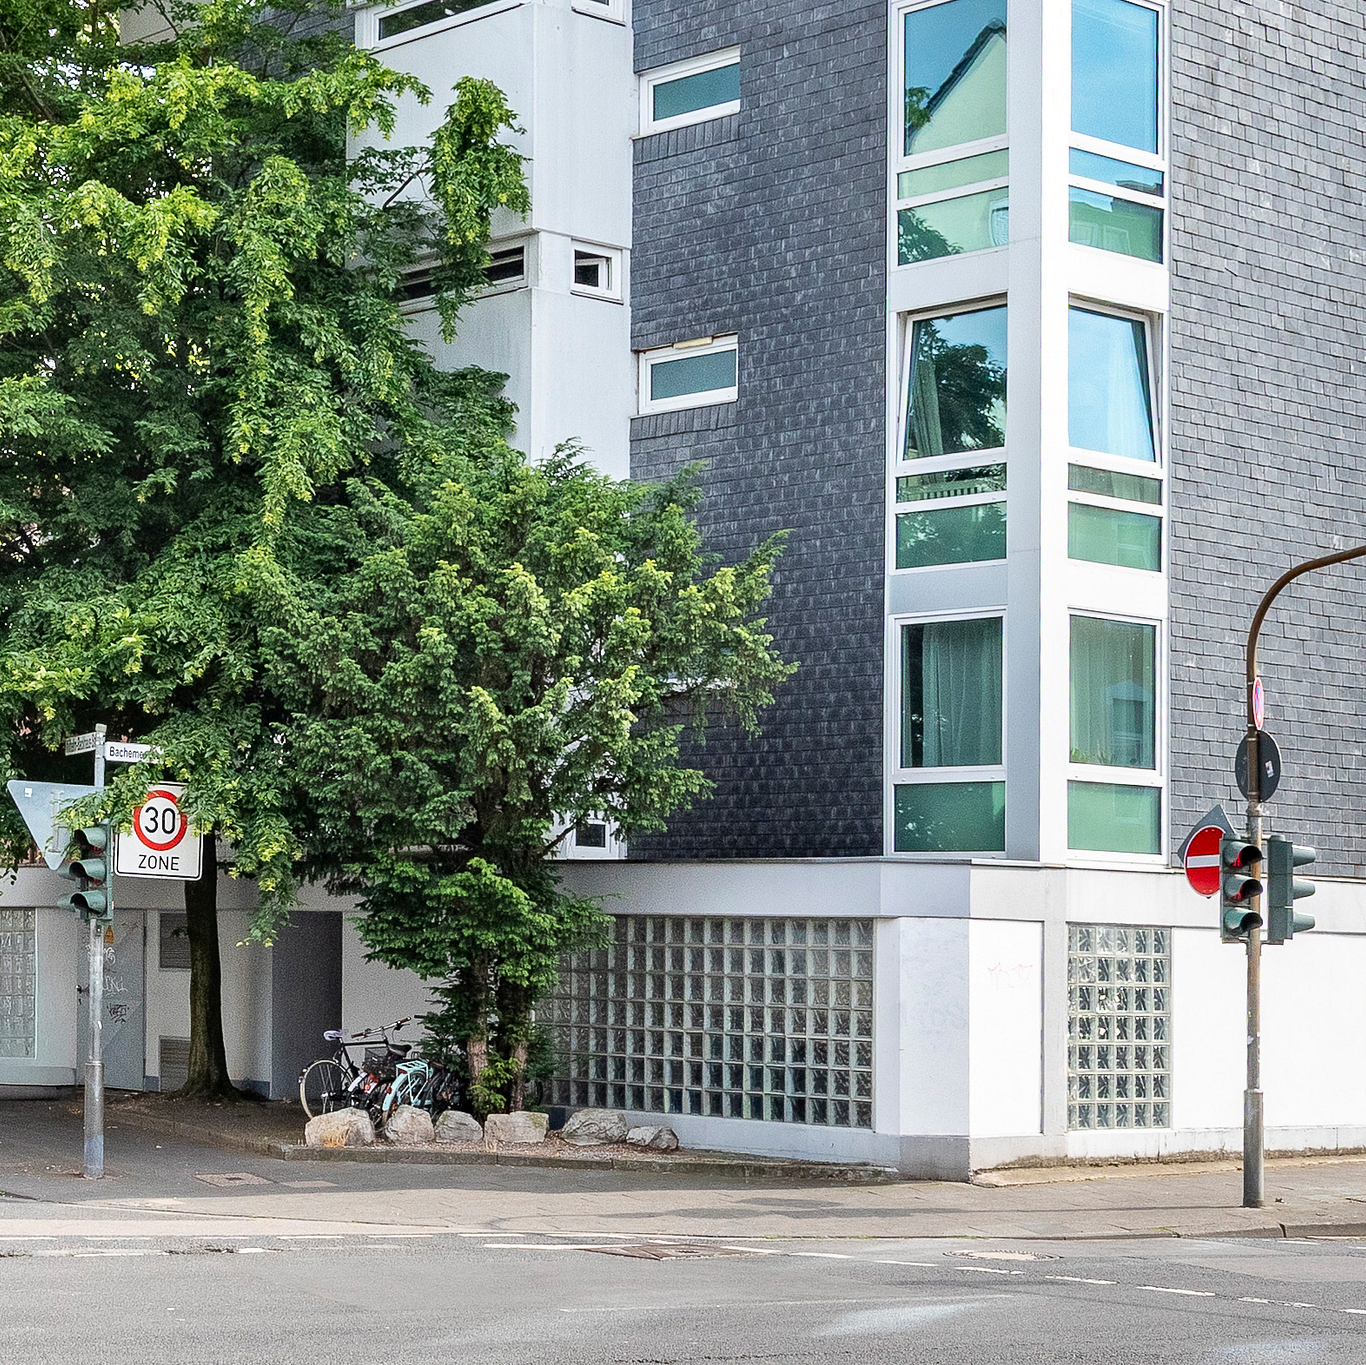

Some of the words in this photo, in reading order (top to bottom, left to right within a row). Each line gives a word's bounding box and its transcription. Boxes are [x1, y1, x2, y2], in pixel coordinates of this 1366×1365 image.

[109, 746, 145, 759] Bacheme
[145, 806, 176, 834] 30
[138, 854, 180, 871] ZONE
